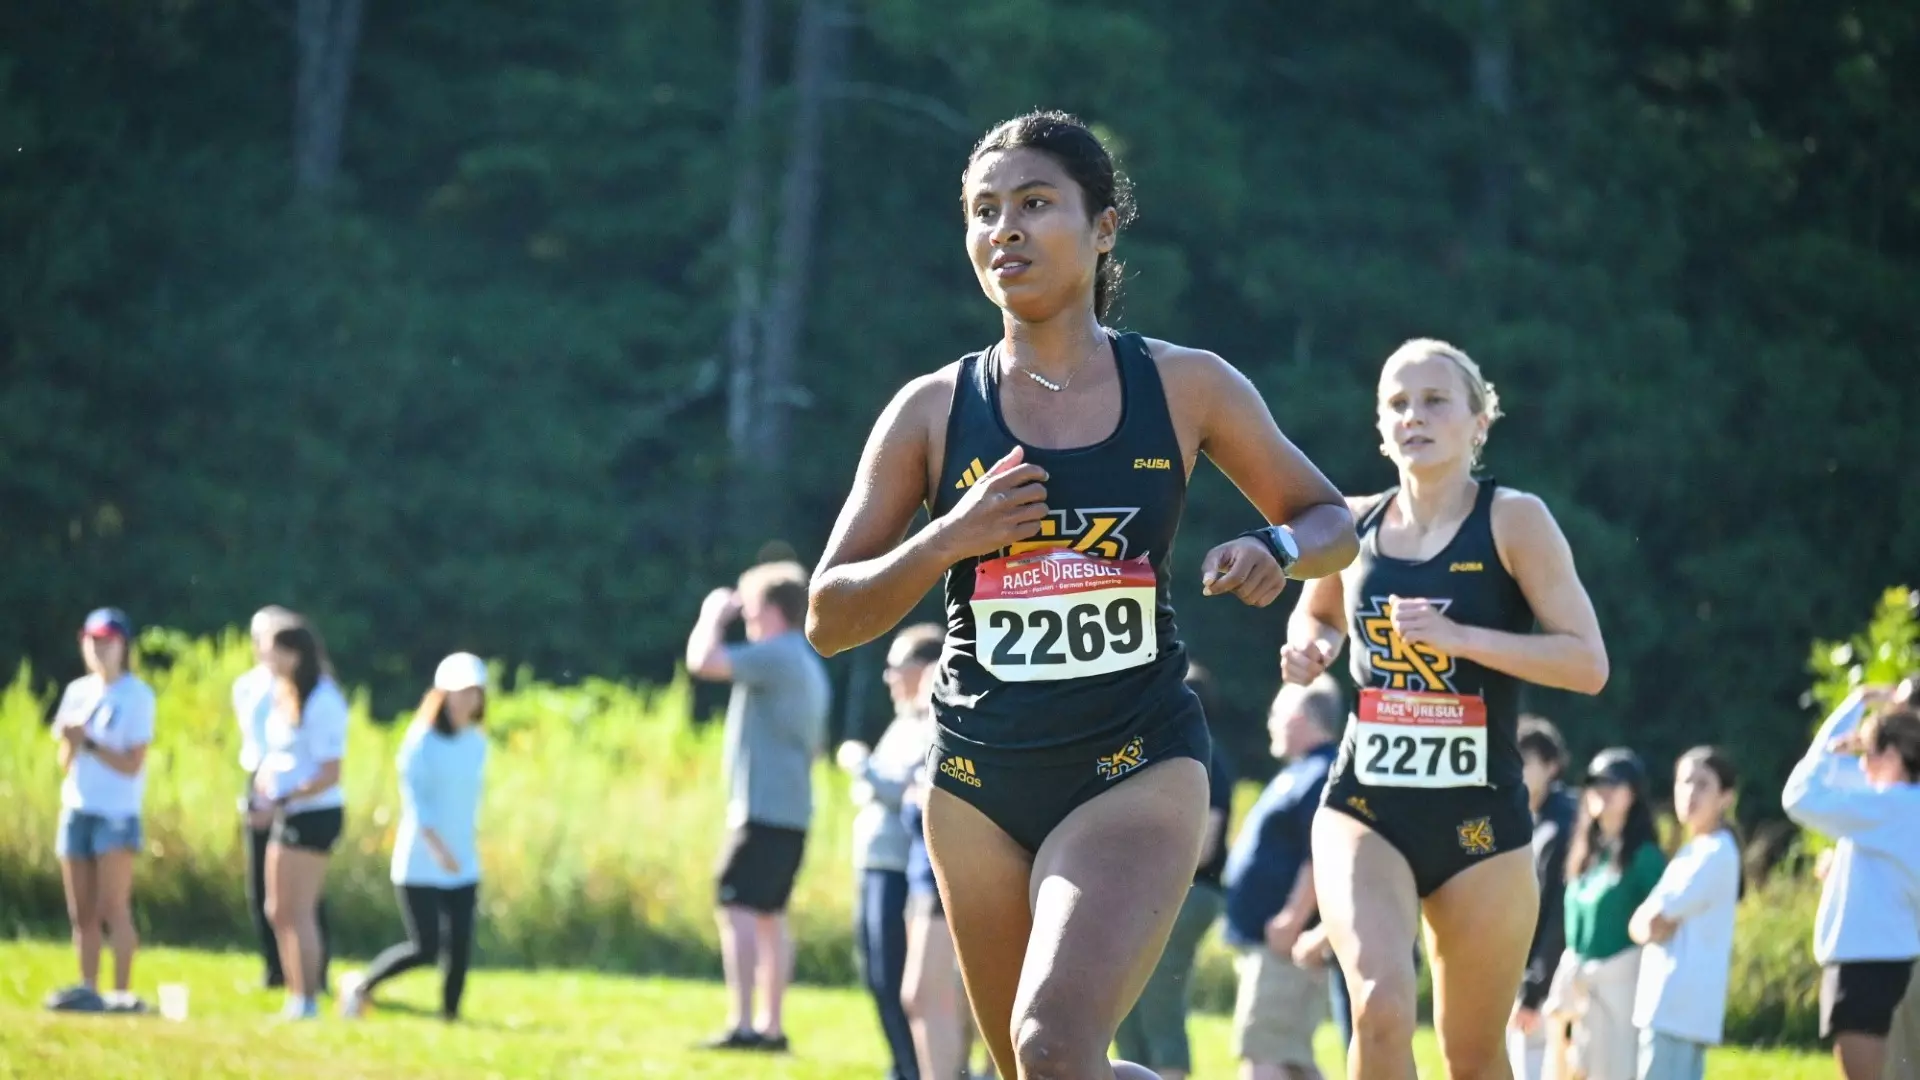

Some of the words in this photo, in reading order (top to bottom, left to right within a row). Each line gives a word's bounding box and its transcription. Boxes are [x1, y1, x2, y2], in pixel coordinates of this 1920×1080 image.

[1003, 568, 1041, 590] RACE
[1062, 563, 1122, 581] RESULT
[1059, 582, 1084, 590] German
[1085, 578, 1122, 588] Engineering
[989, 597, 1144, 666] 2269
[1376, 702, 1405, 716] RACE
[1420, 704, 1465, 718] RESULT
[1365, 733, 1477, 777] 2276
[940, 762, 982, 788] adidas
